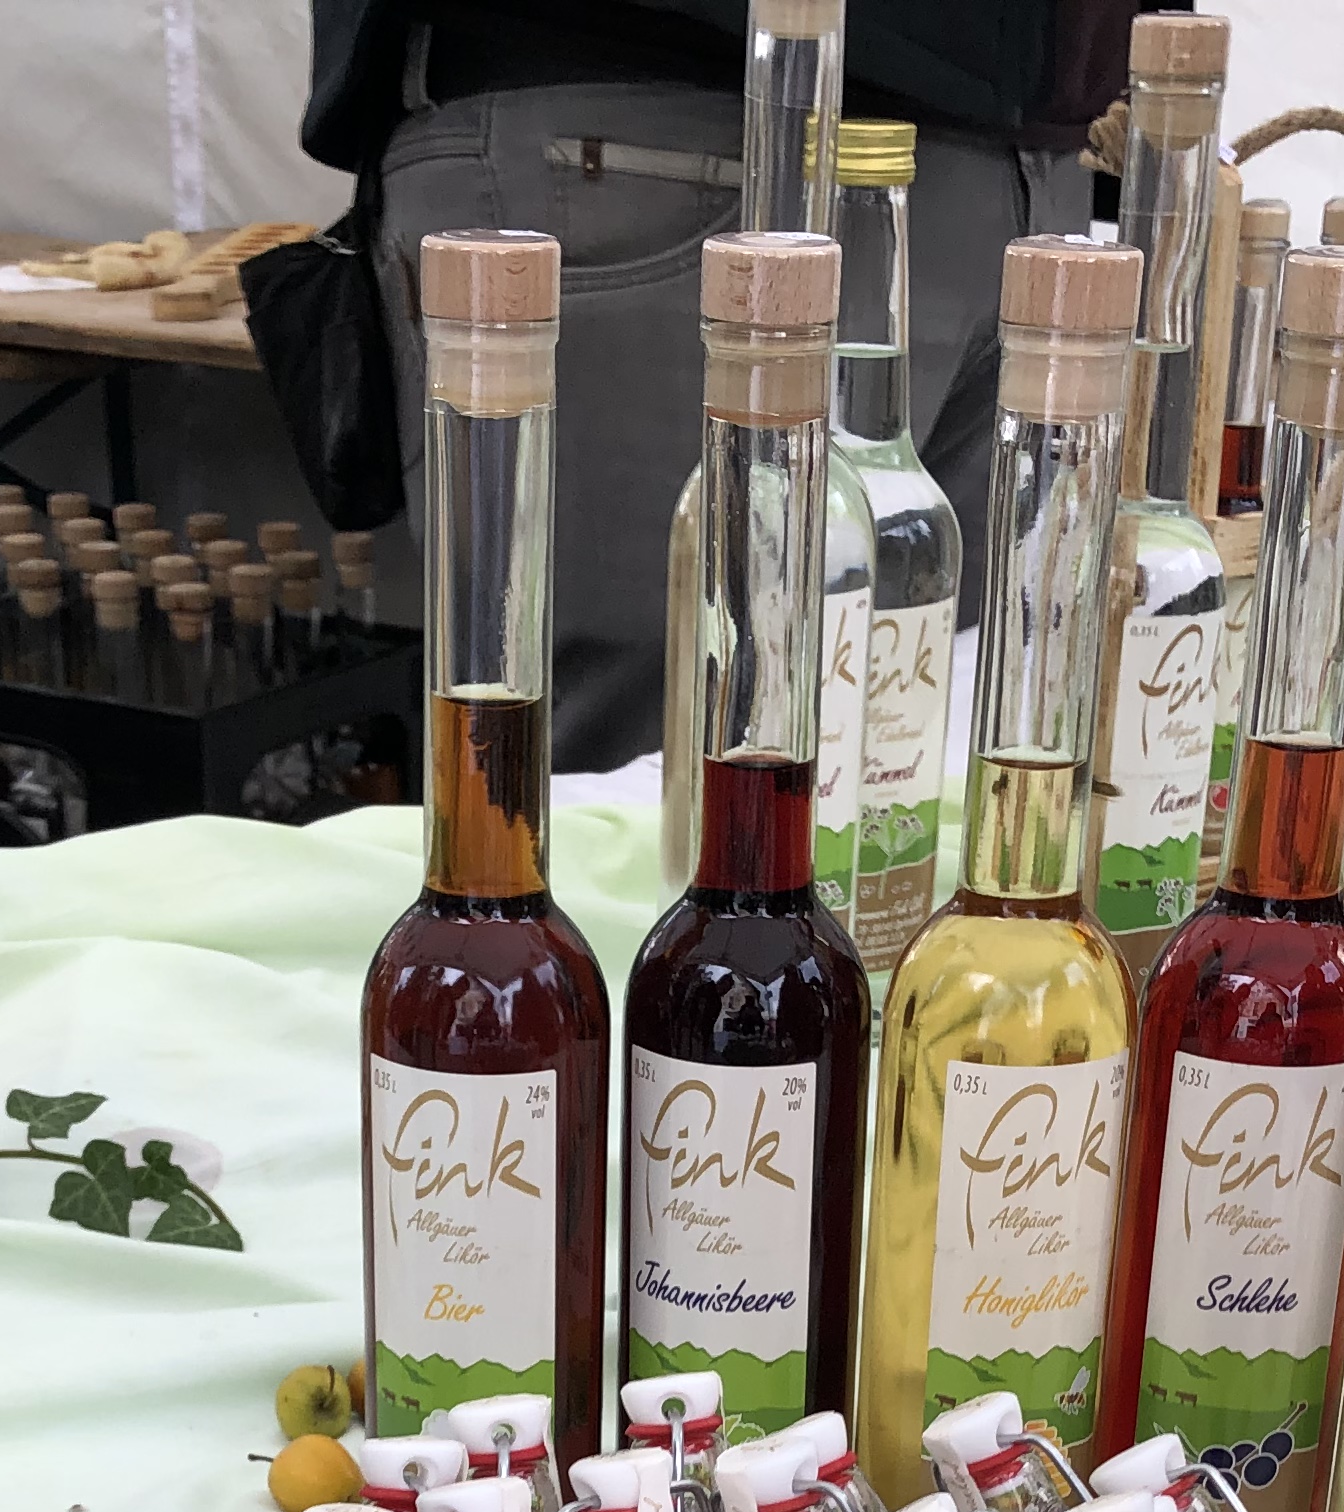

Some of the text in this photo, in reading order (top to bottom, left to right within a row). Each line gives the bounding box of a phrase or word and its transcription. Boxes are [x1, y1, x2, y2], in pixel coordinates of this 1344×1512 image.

[782, 1077, 807, 1096] 20%
[953, 1072, 982, 1094] 0,35
[1178, 1064, 1204, 1088] 0,35
[525, 1084, 550, 1104] 24%
[787, 1096, 802, 1111] vol
[531, 1104, 546, 1119] vol
[382, 1088, 541, 1246] fink
[640, 1079, 796, 1236] fink
[960, 1080, 1110, 1250] fink
[1181, 1082, 1343, 1243] fink
[407, 1208, 477, 1238] Allgäuer
[662, 1198, 731, 1230] Allgäuer
[988, 1204, 1063, 1238] Allgäuer
[1206, 1203, 1282, 1235] Allgäuer
[443, 1241, 490, 1265] Likör
[696, 1231, 744, 1255] Likör
[1028, 1232, 1071, 1256] Likör
[1242, 1231, 1291, 1256] Likör
[423, 1283, 486, 1322] Bier
[635, 1259, 797, 1315] Johannisbeere
[963, 1271, 1090, 1328] Honiglikör
[1196, 1273, 1300, 1314] Schlehe
